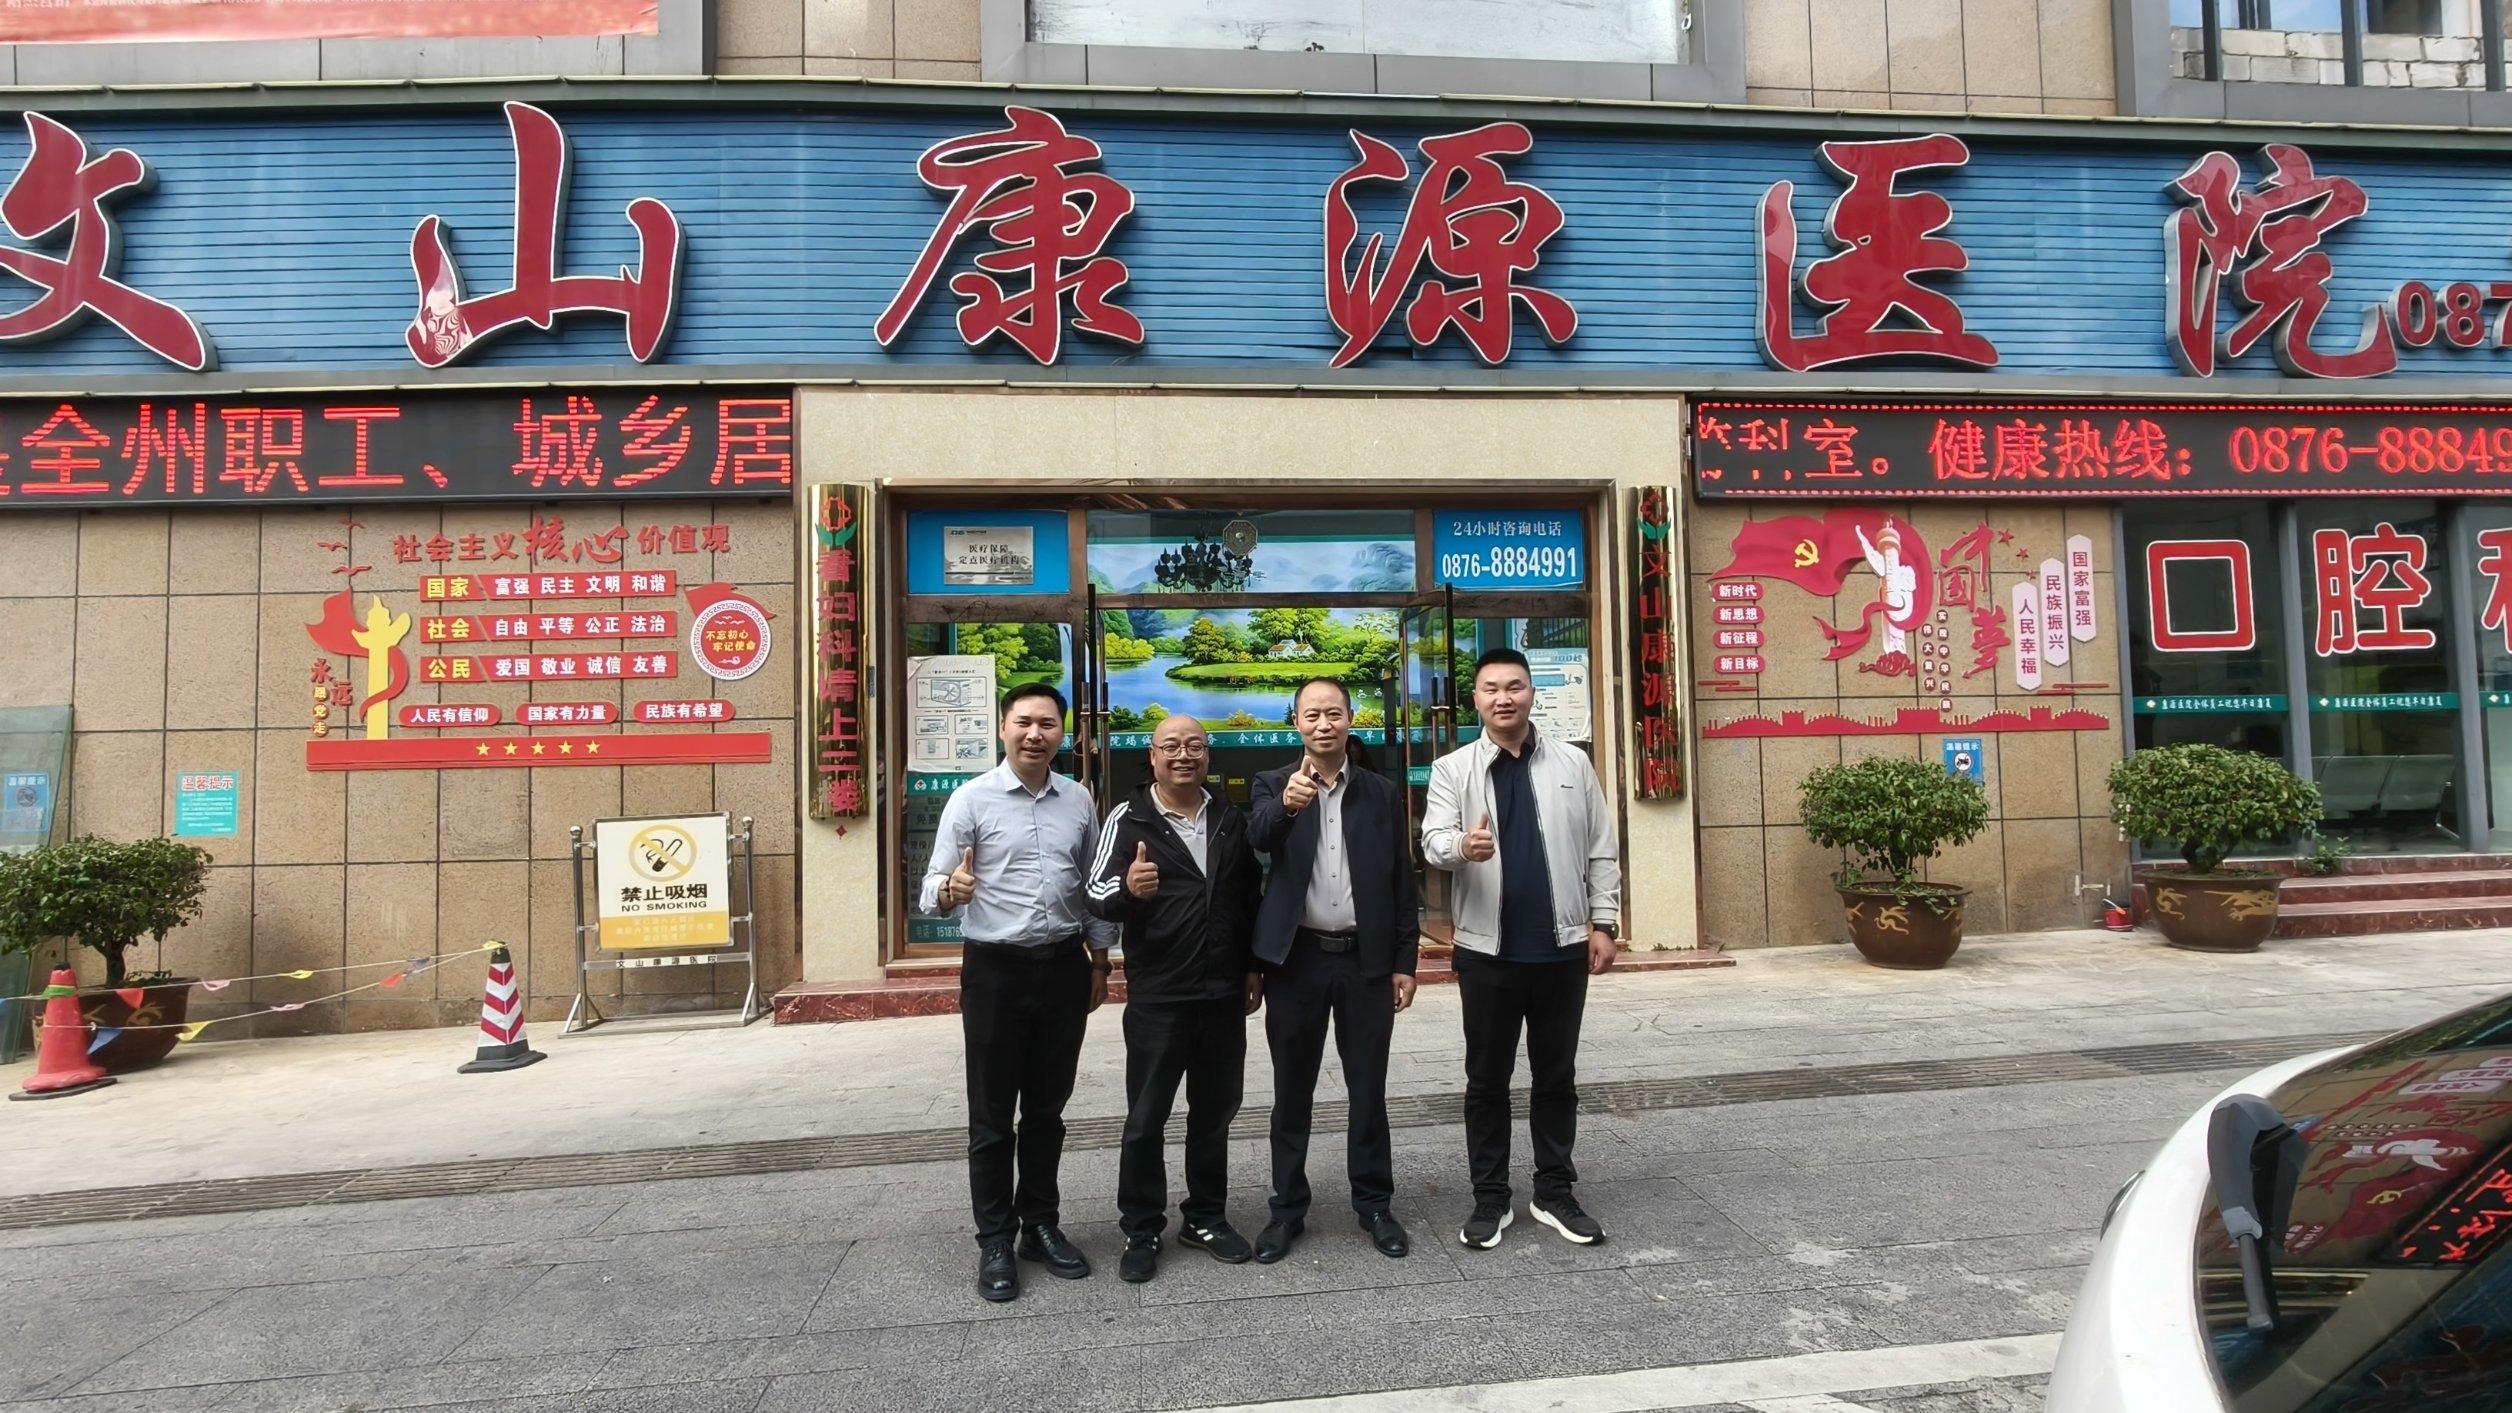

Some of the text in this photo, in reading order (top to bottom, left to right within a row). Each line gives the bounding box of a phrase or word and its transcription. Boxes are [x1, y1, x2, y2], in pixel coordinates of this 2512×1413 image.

[0, 397, 791, 495] 全州职工、城乡居
[1453, 521, 1562, 537] 24小时咨询电话
[392, 516, 731, 565] 社会主义核心价值观
[969, 544, 1008, 553] 医疗保障
[958, 555, 1020, 565] 定点医疗机构
[1441, 546, 1577, 578] 0876-8884991
[426, 574, 666, 598] 国家 富强 民主 文明 和谐
[1719, 584, 1757, 598] 新时代
[2073, 551, 2091, 626] 国家富强
[1719, 607, 1758, 621] 新思想
[2046, 575, 2065, 650] 民族振兴
[427, 615, 666, 639] 社会 自由 平等 公正 法治
[706, 629, 749, 640] 不忘初心
[1719, 631, 1759, 646] 新征程
[2019, 599, 2037, 674] 人民幸福
[713, 640, 756, 652] 牢记使命
[429, 655, 667, 679] 公民 爱国 敬业 诚信 友善
[1720, 656, 1759, 671] 新目标
[815, 550, 861, 815] 看妇科请上二楼
[411, 705, 489, 723] 人民有信仰
[527, 703, 606, 721] 国家有力量
[645, 701, 723, 719] 民族有希望
[182, 775, 234, 791] 温馨提示
[621, 883, 708, 903] 禁止吸烟
[622, 901, 707, 912] NO SMOKING
